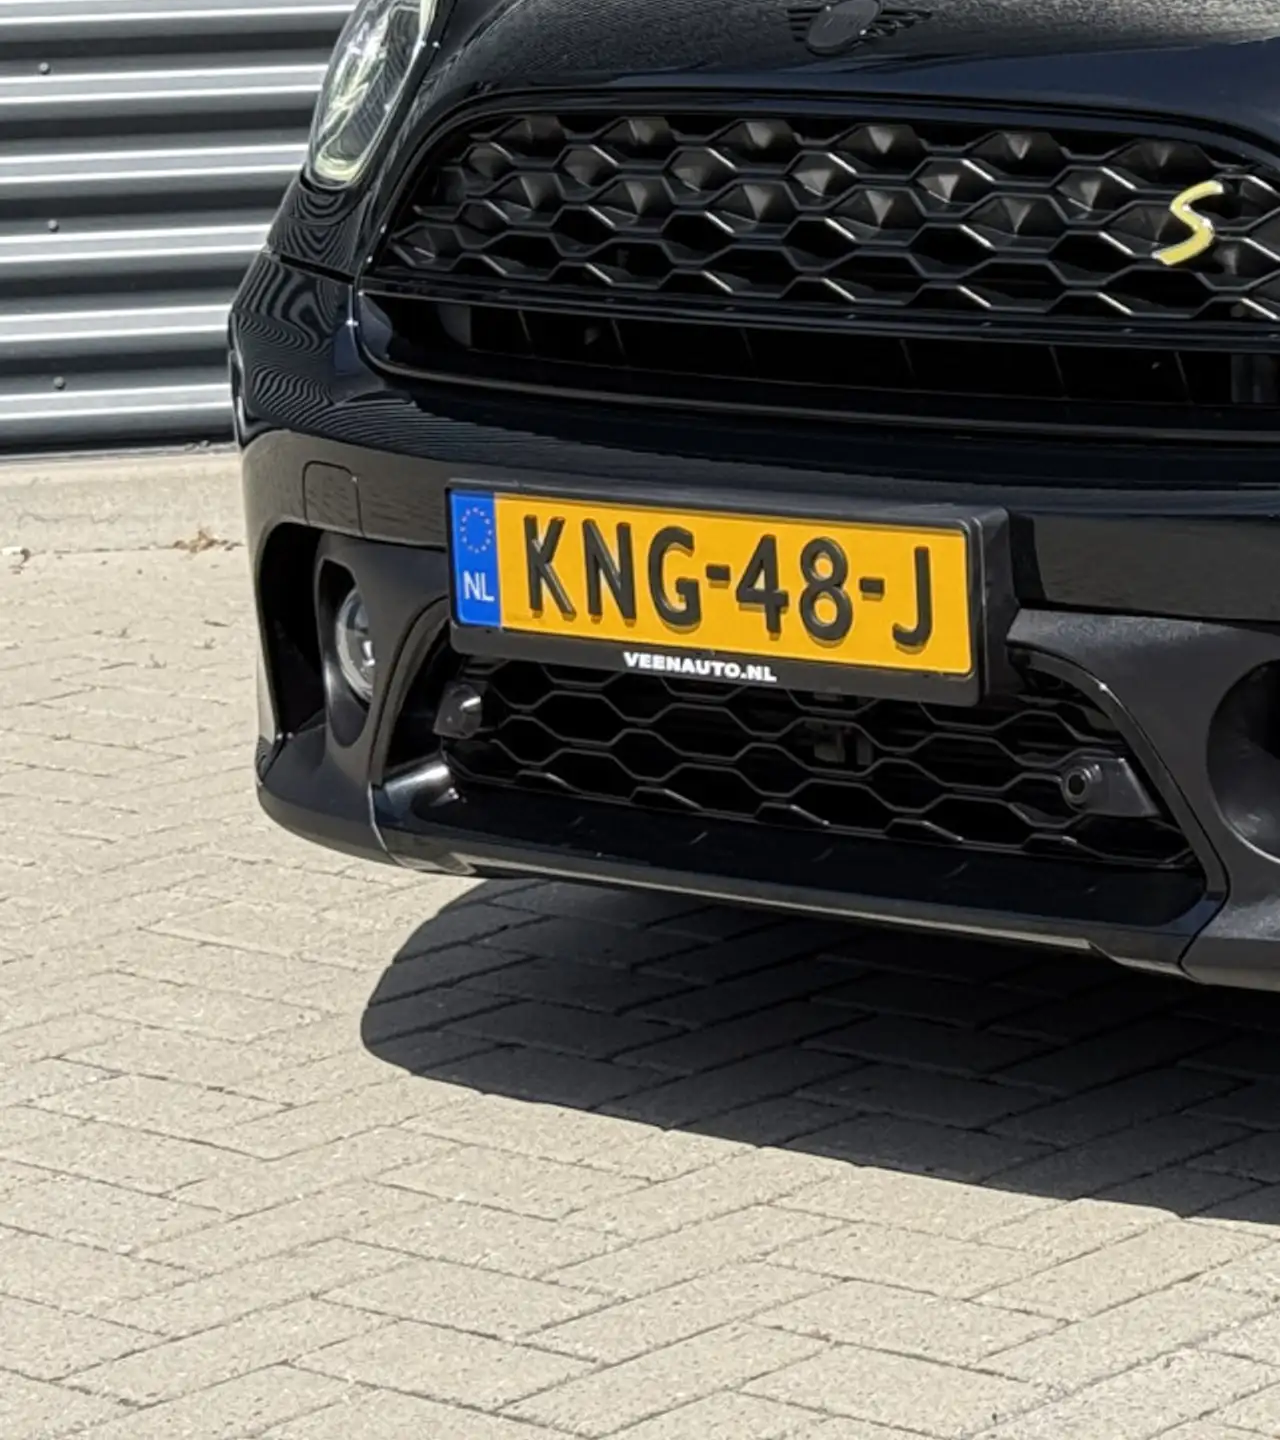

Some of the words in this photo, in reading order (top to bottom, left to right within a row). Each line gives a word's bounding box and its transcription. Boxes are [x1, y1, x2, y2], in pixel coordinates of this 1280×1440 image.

[1151, 180, 1224, 266] S
[463, 570, 495, 603] NL
[523, 513, 935, 656] KNG-48-J
[623, 651, 778, 683] VEENAUTO.NL
